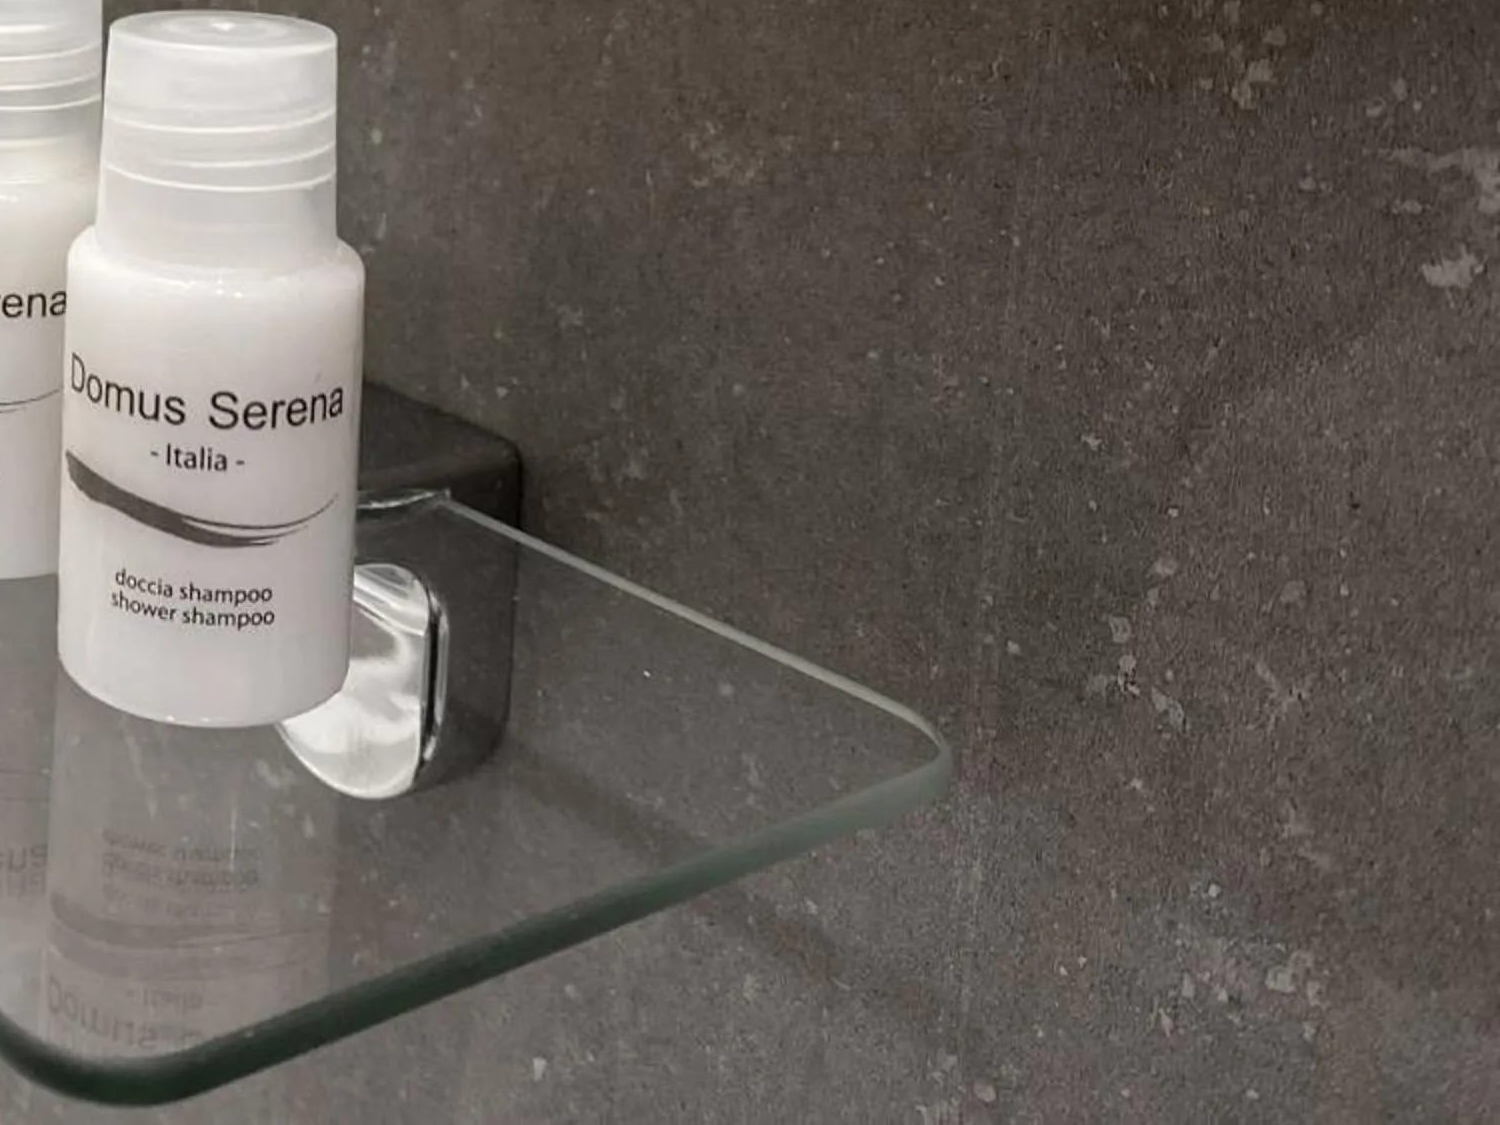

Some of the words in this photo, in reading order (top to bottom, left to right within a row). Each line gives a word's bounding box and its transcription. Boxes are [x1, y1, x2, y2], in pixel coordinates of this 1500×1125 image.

[71, 352, 186, 425] Domus
[208, 387, 344, 430] Serena
[166, 443, 227, 472] Italia
[115, 568, 173, 598] doccia
[179, 581, 273, 607] shampoo
[111, 591, 177, 620] shower
[182, 607, 275, 631] shampoo
